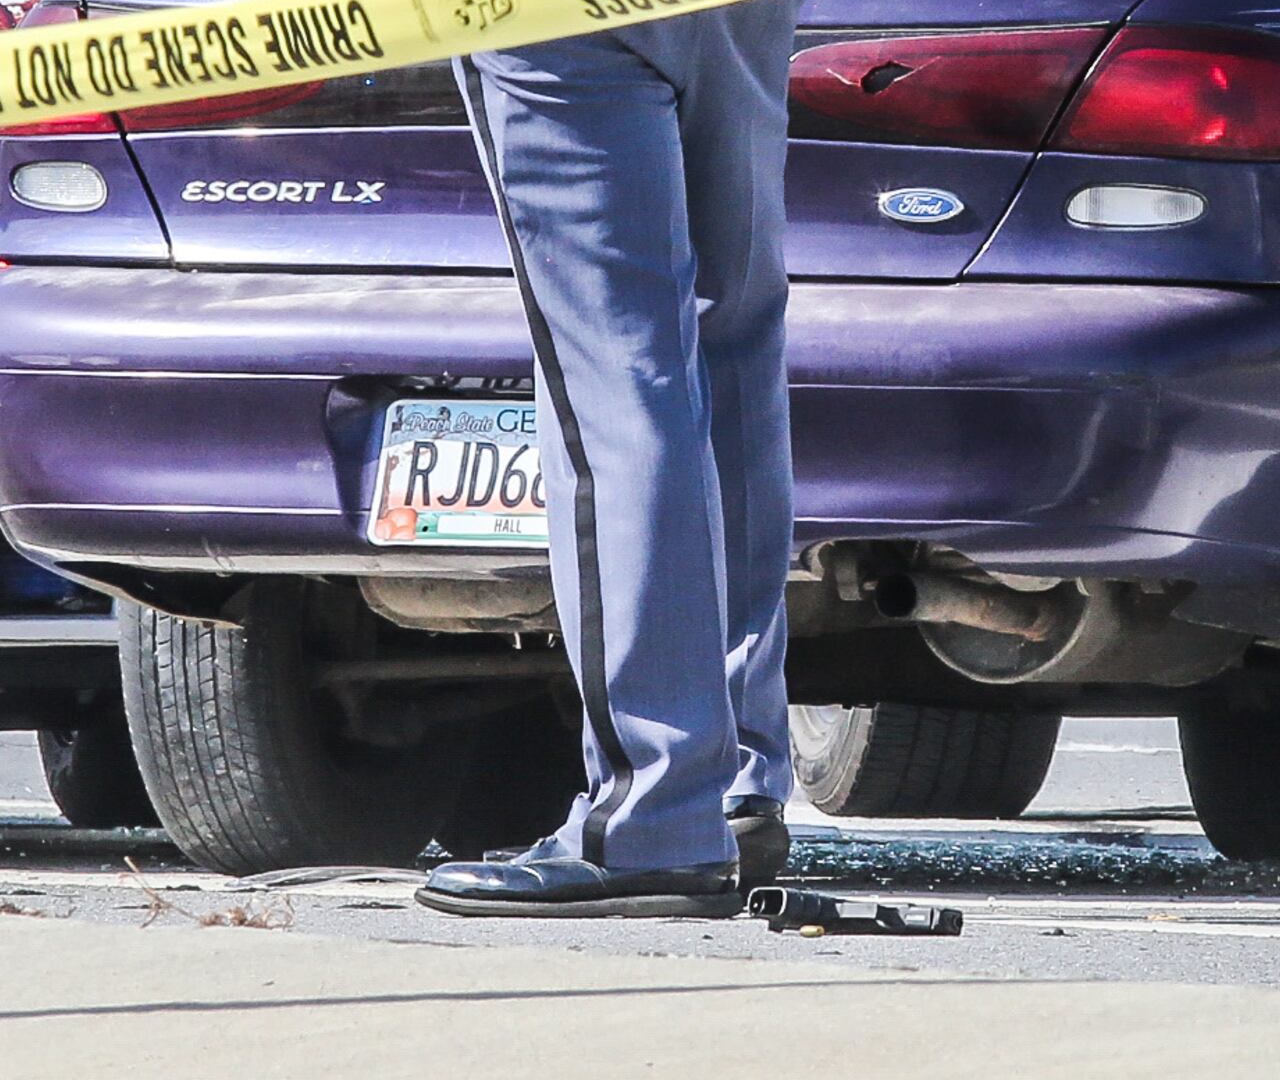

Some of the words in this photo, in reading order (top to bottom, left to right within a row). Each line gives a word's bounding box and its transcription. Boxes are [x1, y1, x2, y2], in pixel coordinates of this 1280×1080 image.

[140, 17, 260, 88] SCENE
[256, 0, 384, 72] CRIME
[14, 42, 84, 108] NOT
[86, 34, 139, 97] DO
[181, 180, 325, 203] ESCORT
[331, 180, 386, 203] LX
[898, 195, 942, 216] Ford
[404, 411, 450, 432] Peach
[453, 411, 493, 432] State
[494, 518, 522, 534] HALL
